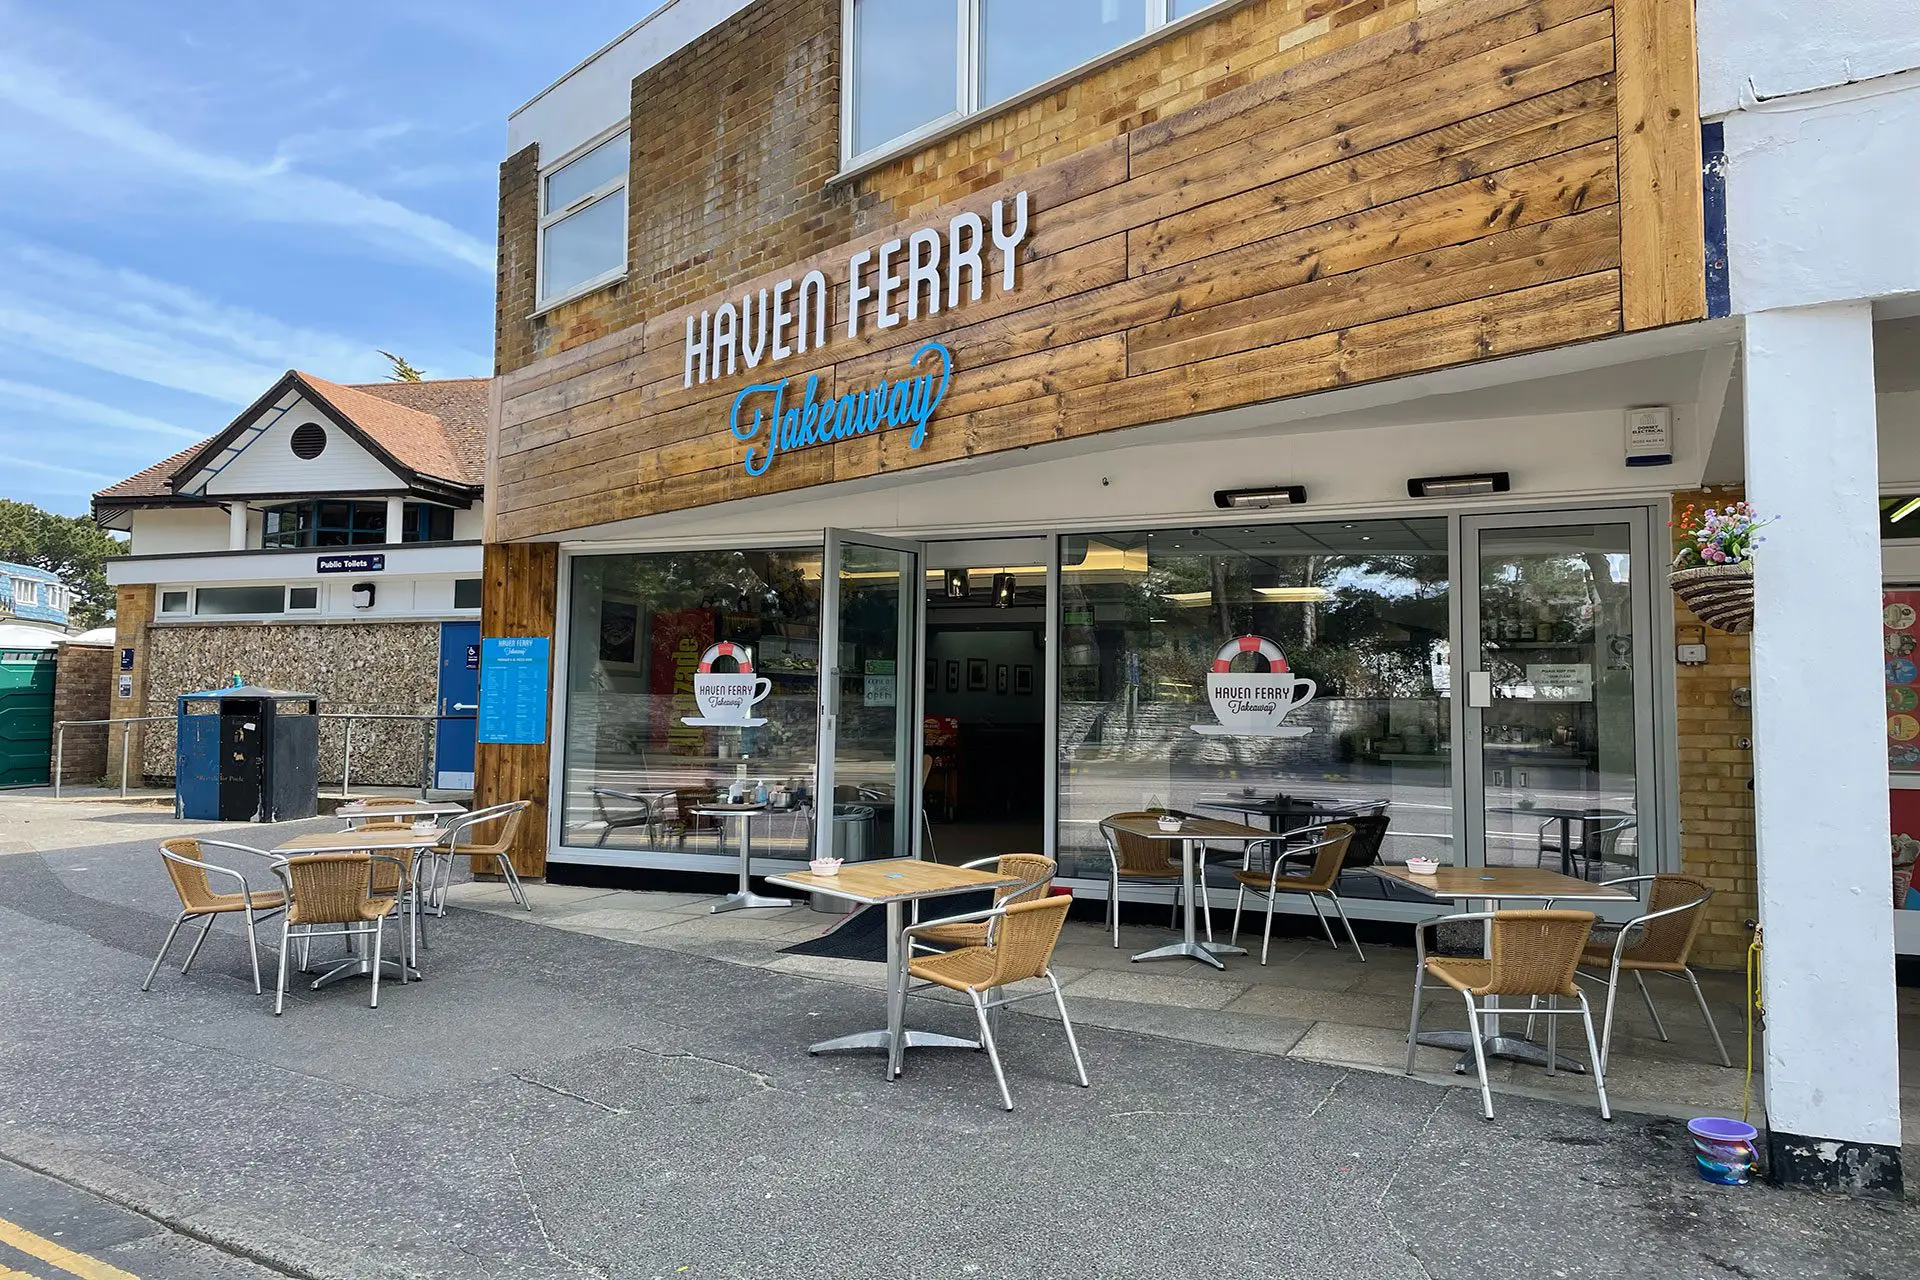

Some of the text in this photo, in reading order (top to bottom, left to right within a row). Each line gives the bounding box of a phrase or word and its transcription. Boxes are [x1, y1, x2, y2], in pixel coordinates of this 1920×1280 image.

[684, 190, 1028, 388] HAVEN FERRY
[730, 342, 952, 477] Takeaway
[343, 560, 368, 568] Toilets
[699, 685, 753, 696] HAVEN FERRY
[867, 692, 892, 701] OPEN
[1215, 687, 1290, 699] HAVEN FERRY
[708, 695, 744, 709] Takeaway
[1227, 699, 1277, 715] Takeaway
